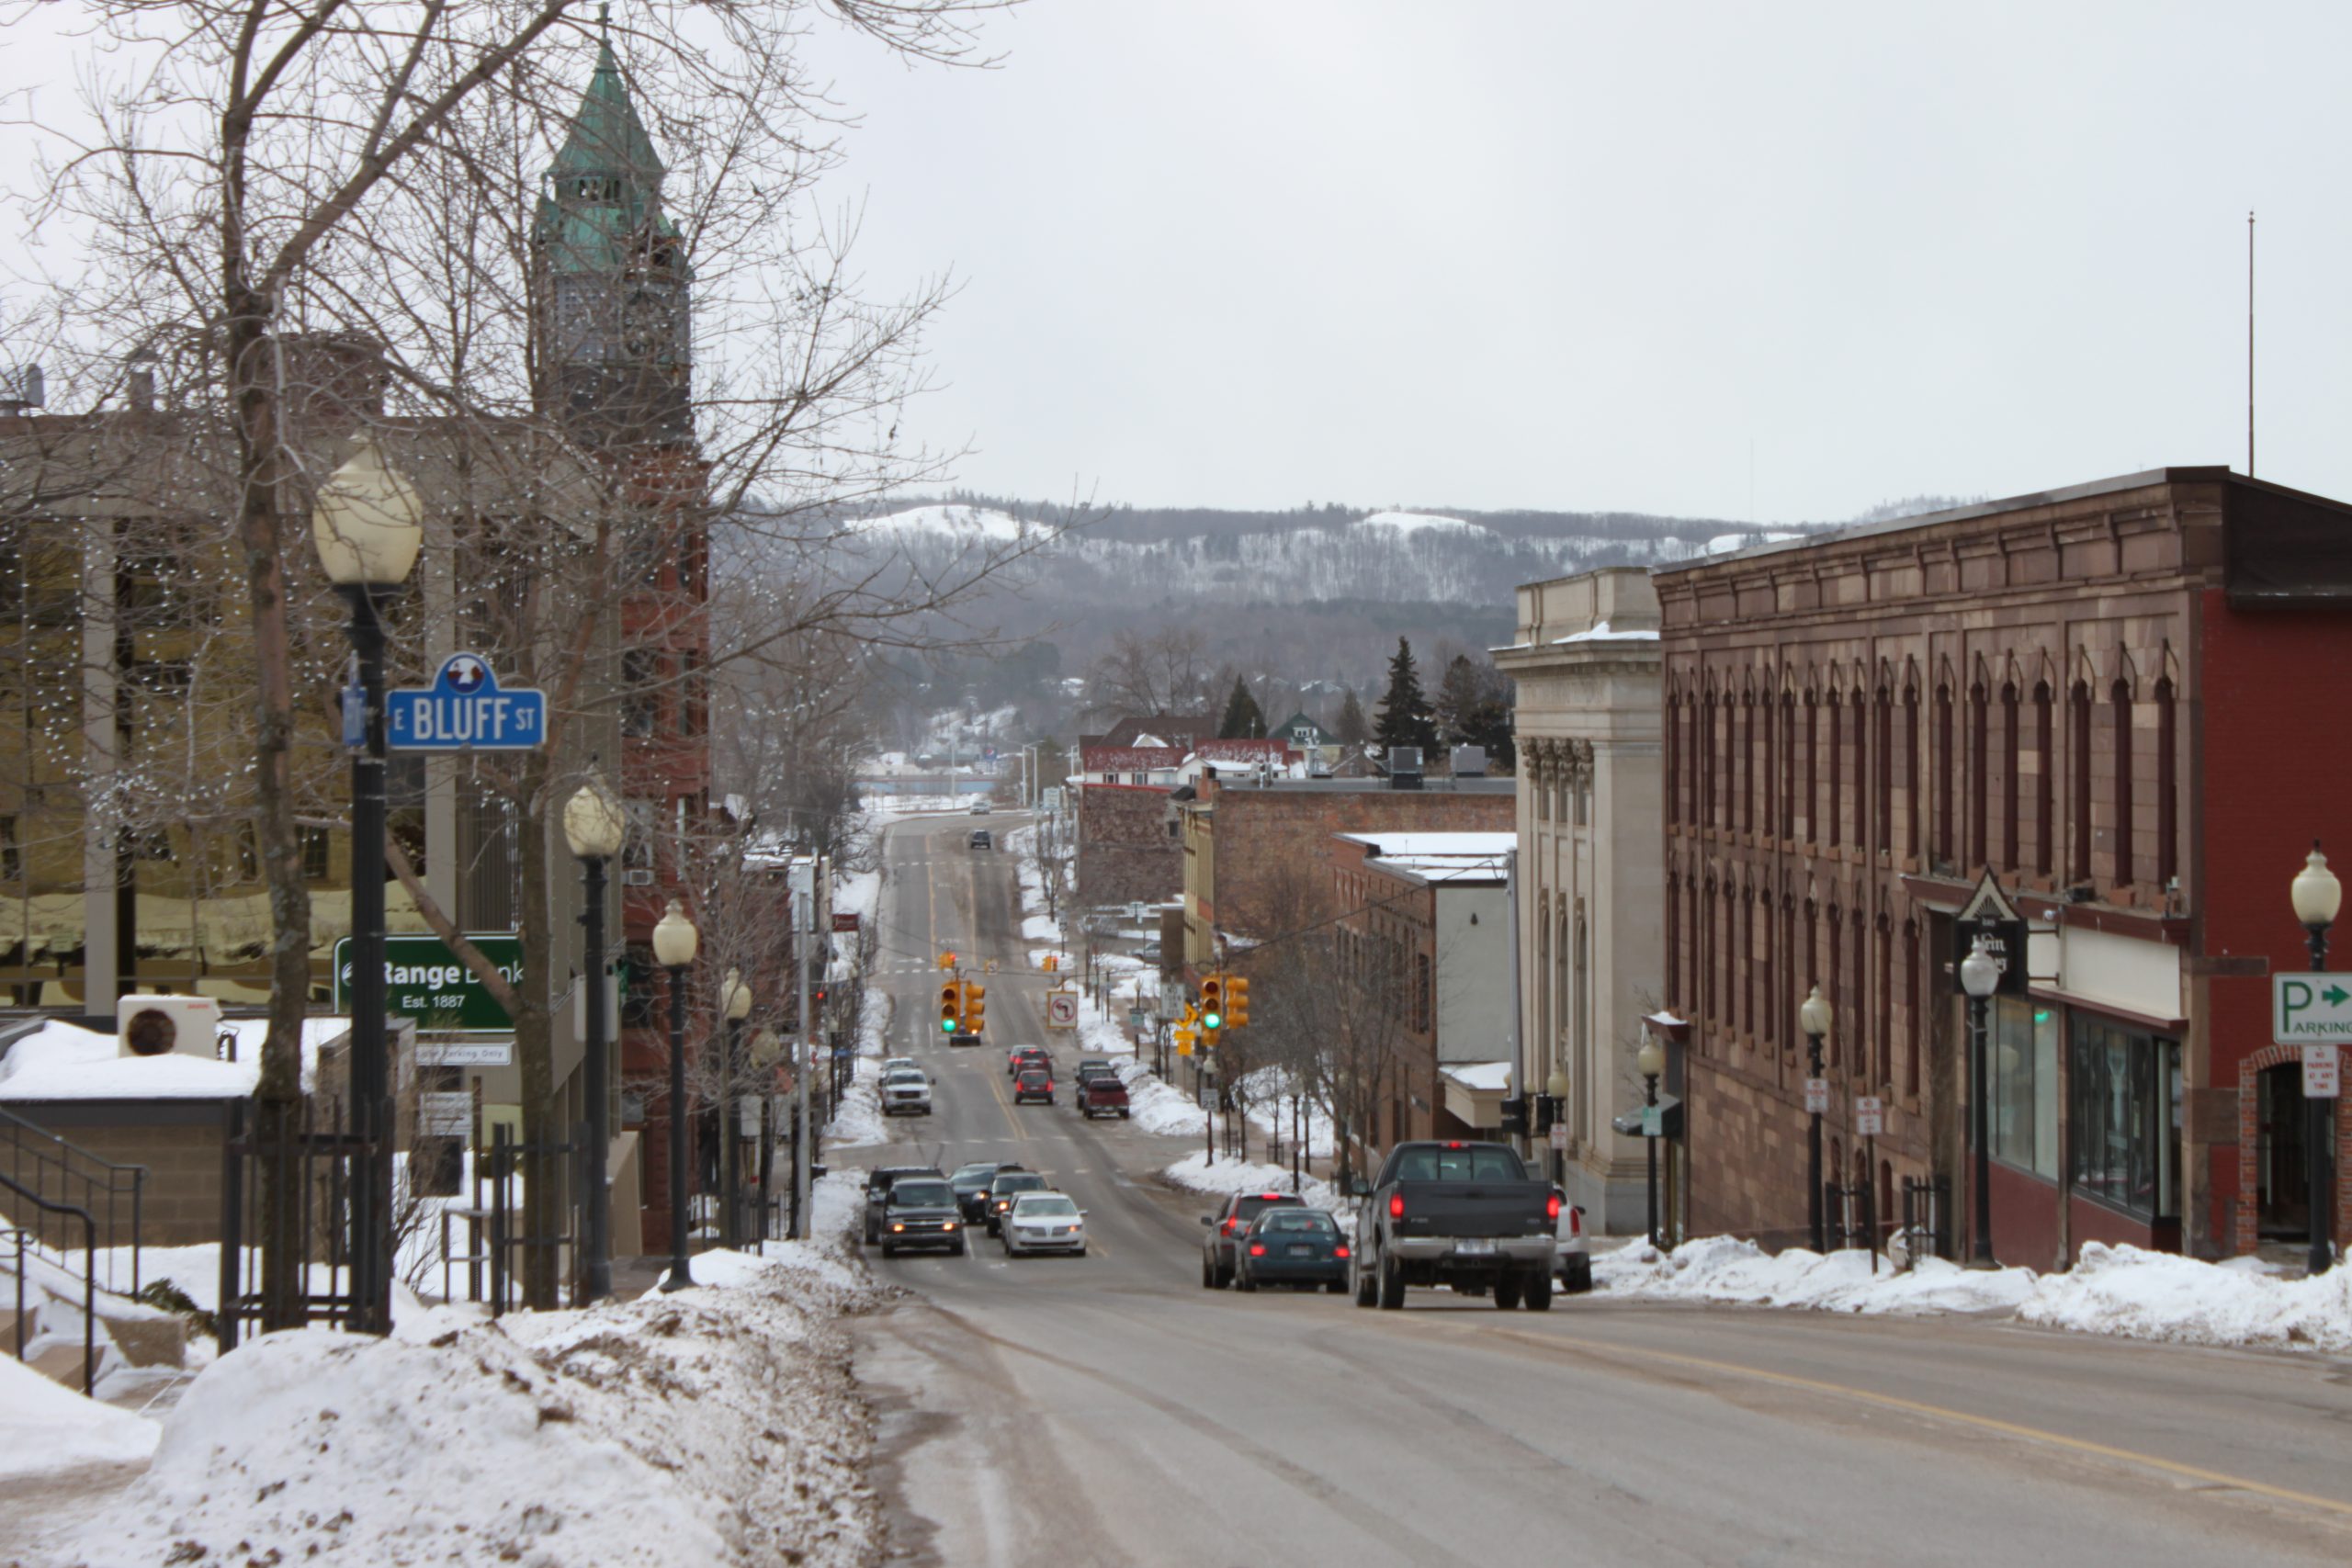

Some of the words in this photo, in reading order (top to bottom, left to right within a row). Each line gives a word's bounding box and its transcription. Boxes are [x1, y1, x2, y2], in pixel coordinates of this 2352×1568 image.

[394, 708, 404, 730] E
[414, 698, 512, 739] BLUFF
[515, 708, 535, 730] ST
[384, 961, 459, 990] Range
[466, 960, 524, 985] Bnk
[1167, 984, 1177, 993] NO
[402, 995, 428, 1009] Est.
[433, 995, 466, 1009] 1887
[481, 1049, 503, 1059] Only
[1202, 1101, 1216, 1110] 25
